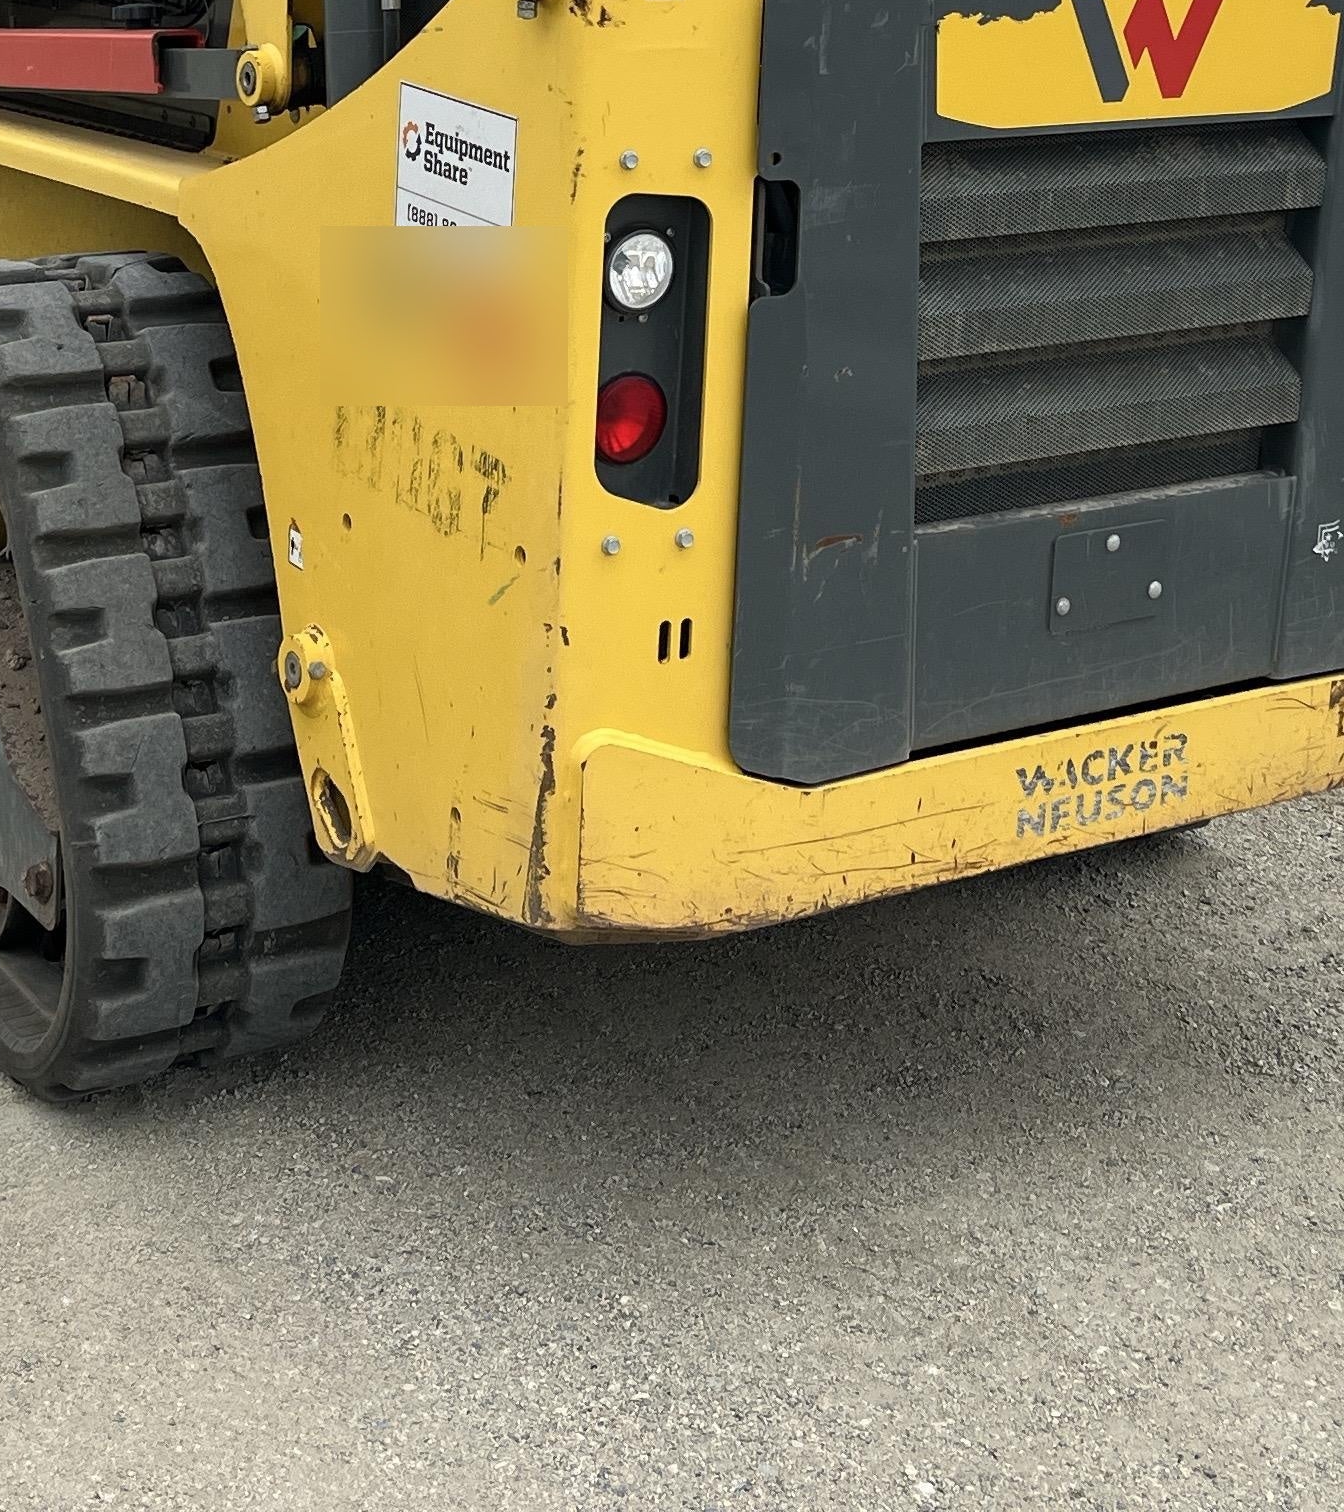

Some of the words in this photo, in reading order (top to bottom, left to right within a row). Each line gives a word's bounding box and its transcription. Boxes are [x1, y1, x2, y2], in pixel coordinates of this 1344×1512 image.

[423, 149, 468, 186] Share
[424, 121, 511, 173] Equipment
[1016, 774, 1189, 839] NEUSON
